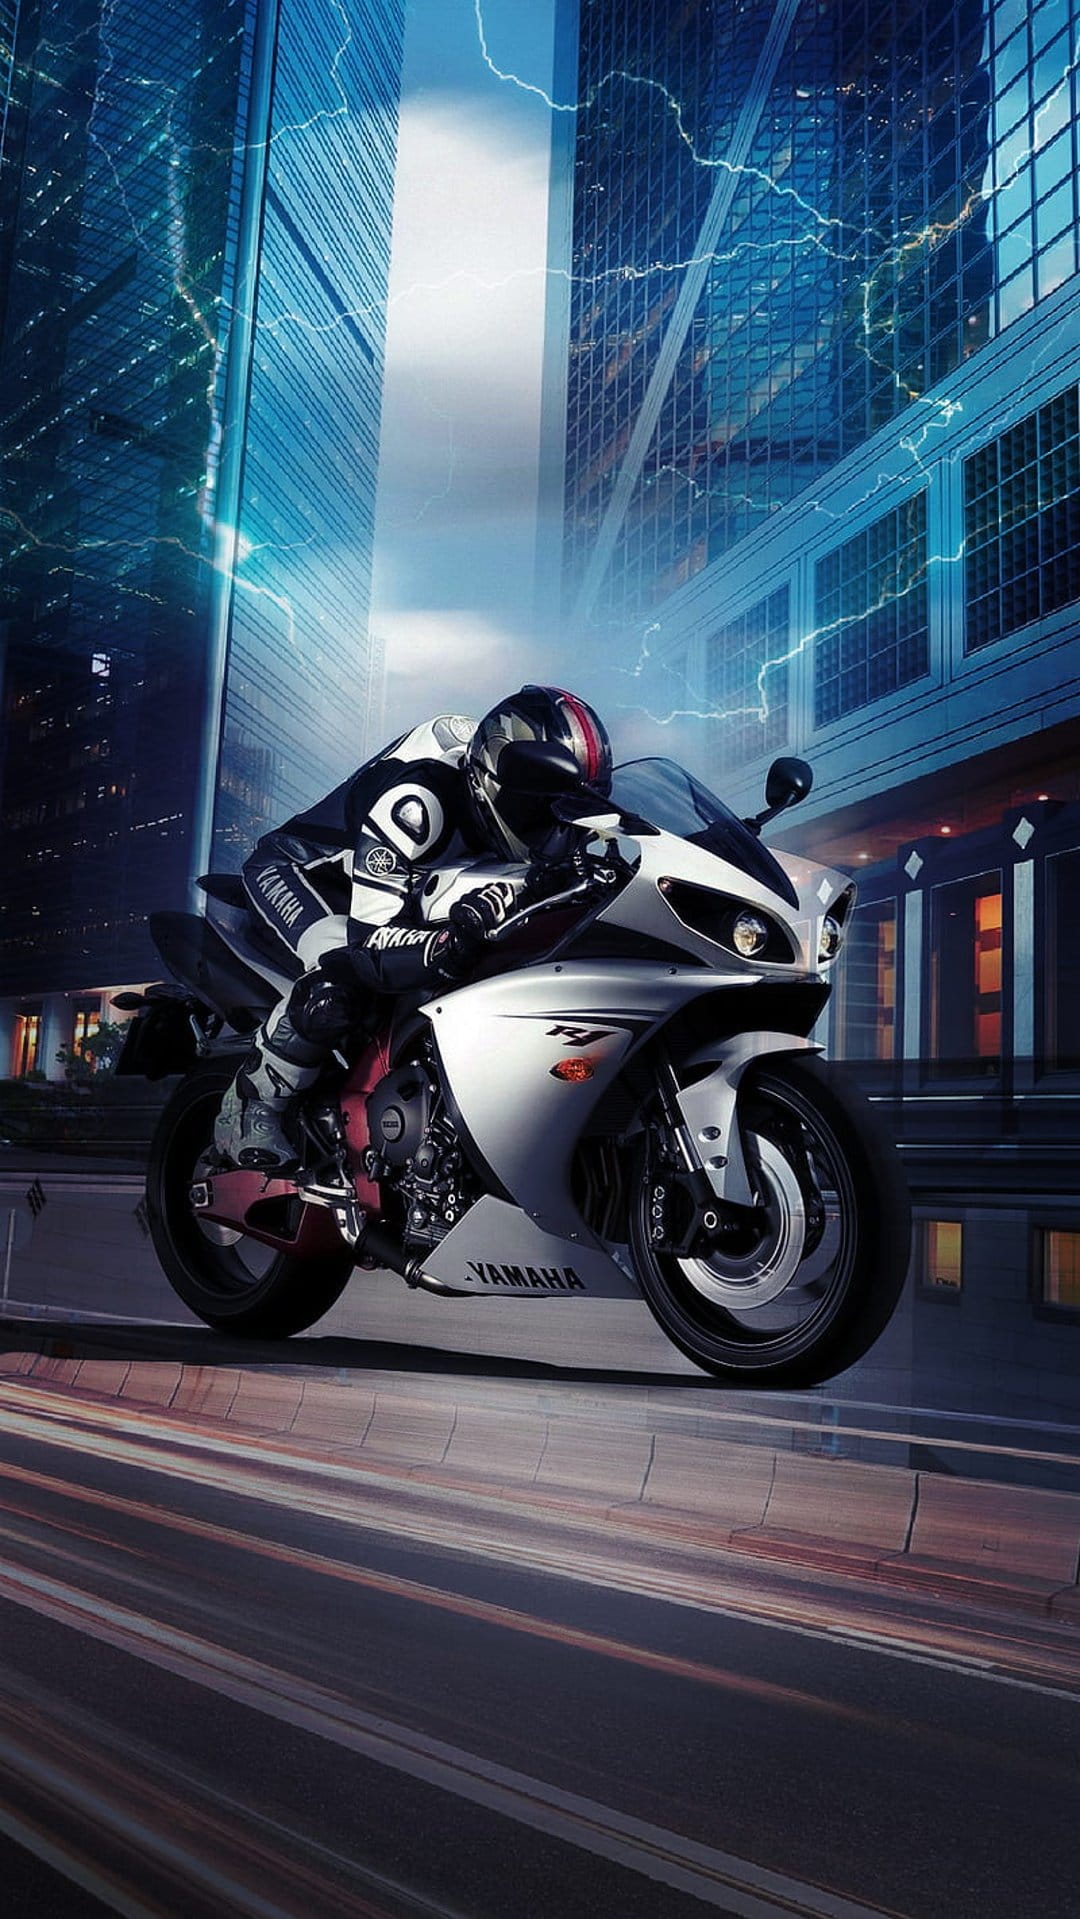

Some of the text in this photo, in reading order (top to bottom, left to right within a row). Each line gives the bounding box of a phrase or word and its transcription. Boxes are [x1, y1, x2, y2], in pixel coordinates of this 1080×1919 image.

[256, 865, 304, 928] YAMAHA
[545, 1024, 619, 1047] R1
[466, 1261, 588, 1290] YAMAHA
